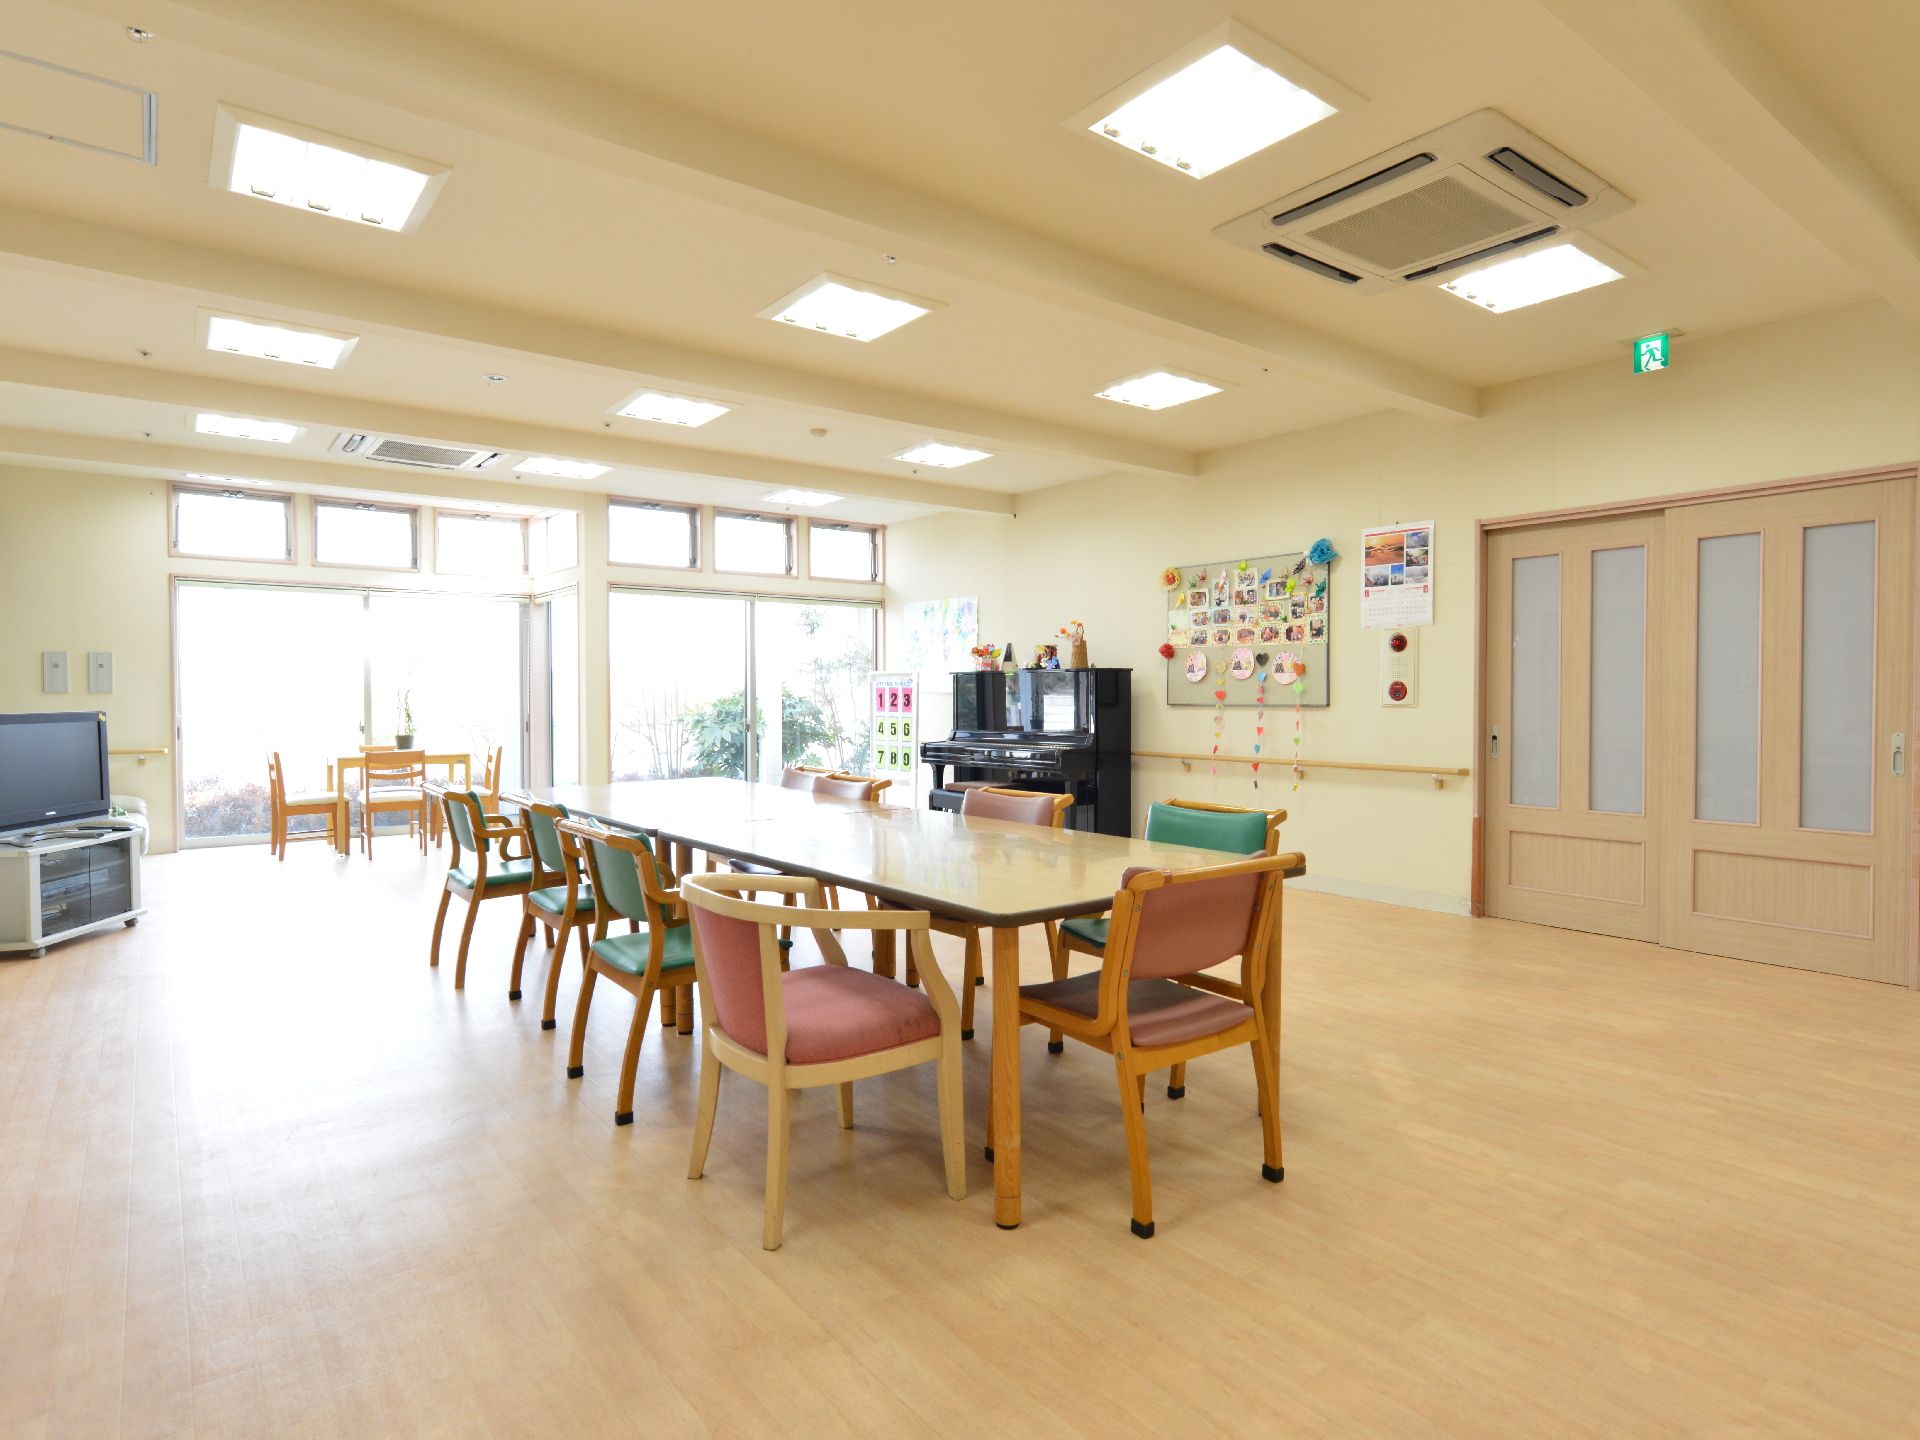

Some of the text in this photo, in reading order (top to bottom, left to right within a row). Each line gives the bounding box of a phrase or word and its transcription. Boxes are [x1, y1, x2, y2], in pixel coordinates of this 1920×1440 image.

[878, 692, 911, 708] 1 2 3
[878, 721, 910, 736] 4 5 6
[877, 750, 910, 766] 7 8 9
